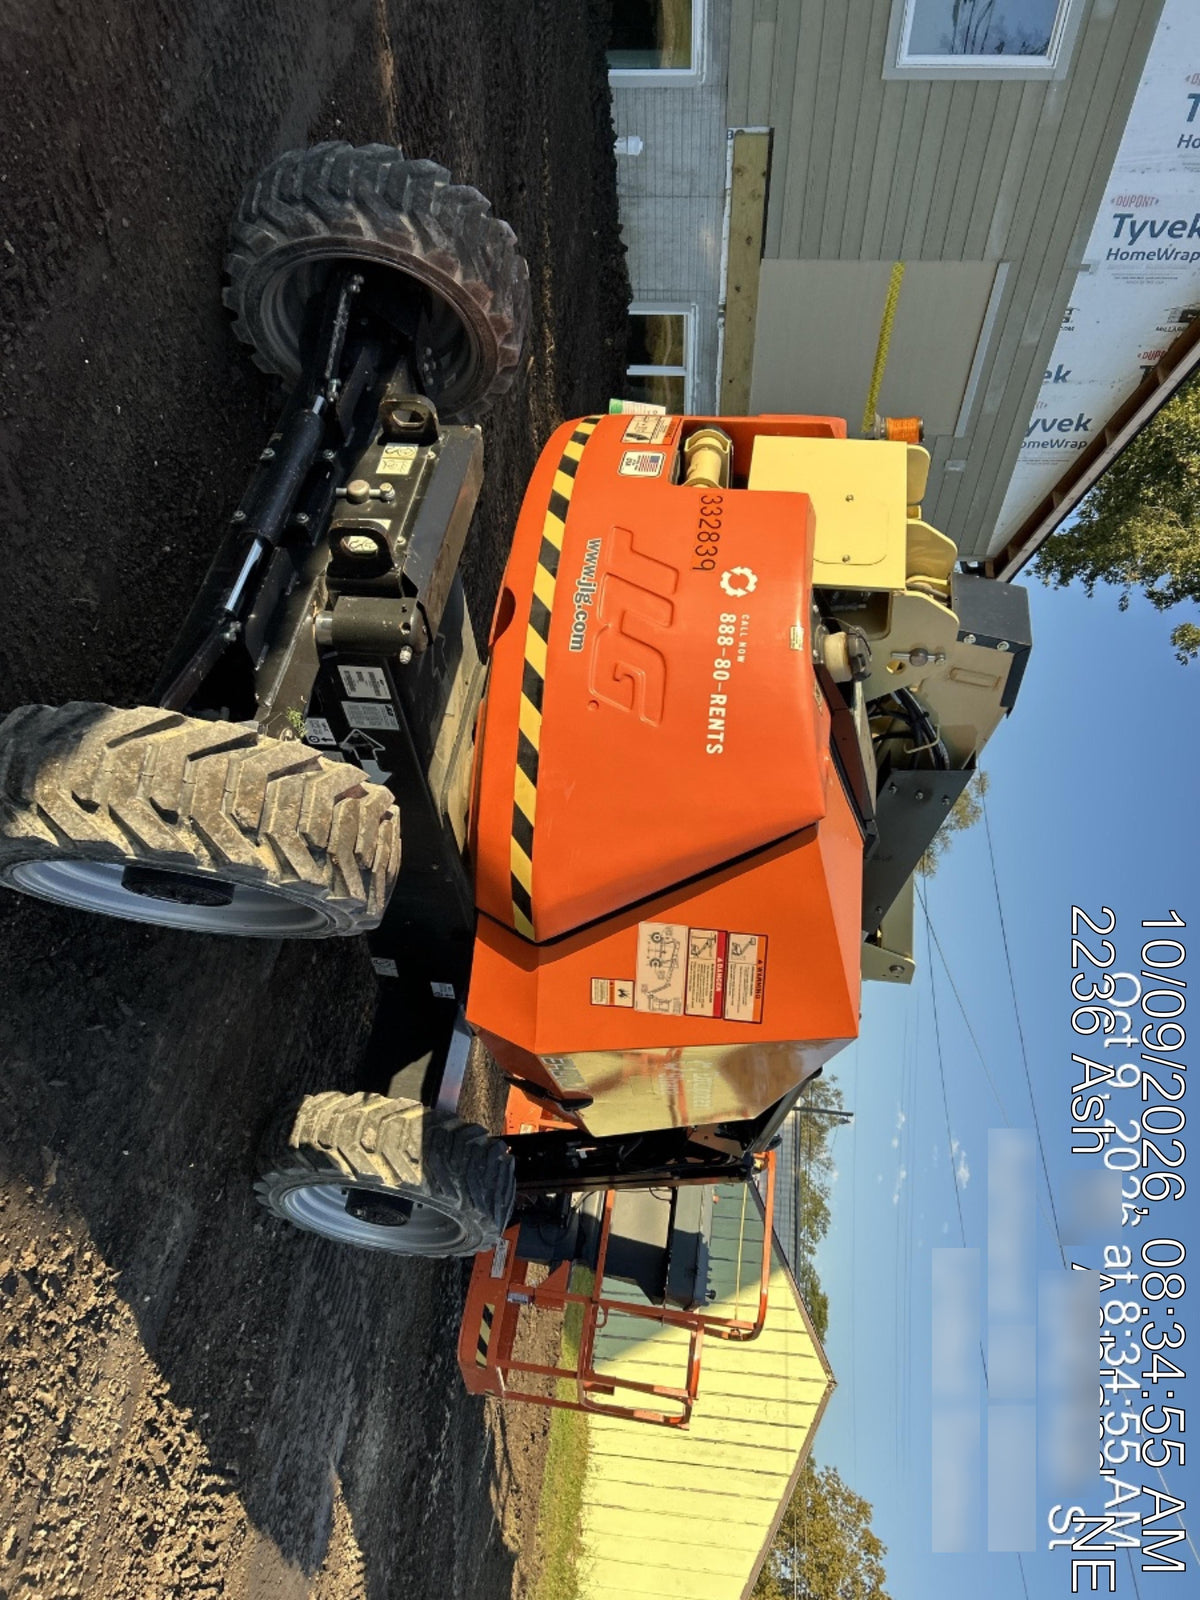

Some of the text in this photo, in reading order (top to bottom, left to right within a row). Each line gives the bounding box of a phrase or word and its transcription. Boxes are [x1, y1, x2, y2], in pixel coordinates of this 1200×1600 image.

[1115, 194, 1156, 208] DUPONT
[1112, 212, 1200, 246] Tyvek
[1106, 247, 1200, 263] HomeWrap
[1021, 438, 1088, 450] omeWrap
[1025, 412, 1093, 438] yvek
[692, 494, 724, 572] 332839
[569, 538, 602, 652] www.jlg.com
[587, 526, 680, 728] JLG
[737, 614, 750, 663] CALL NOW
[705, 612, 737, 755] 888-80-RENTS
